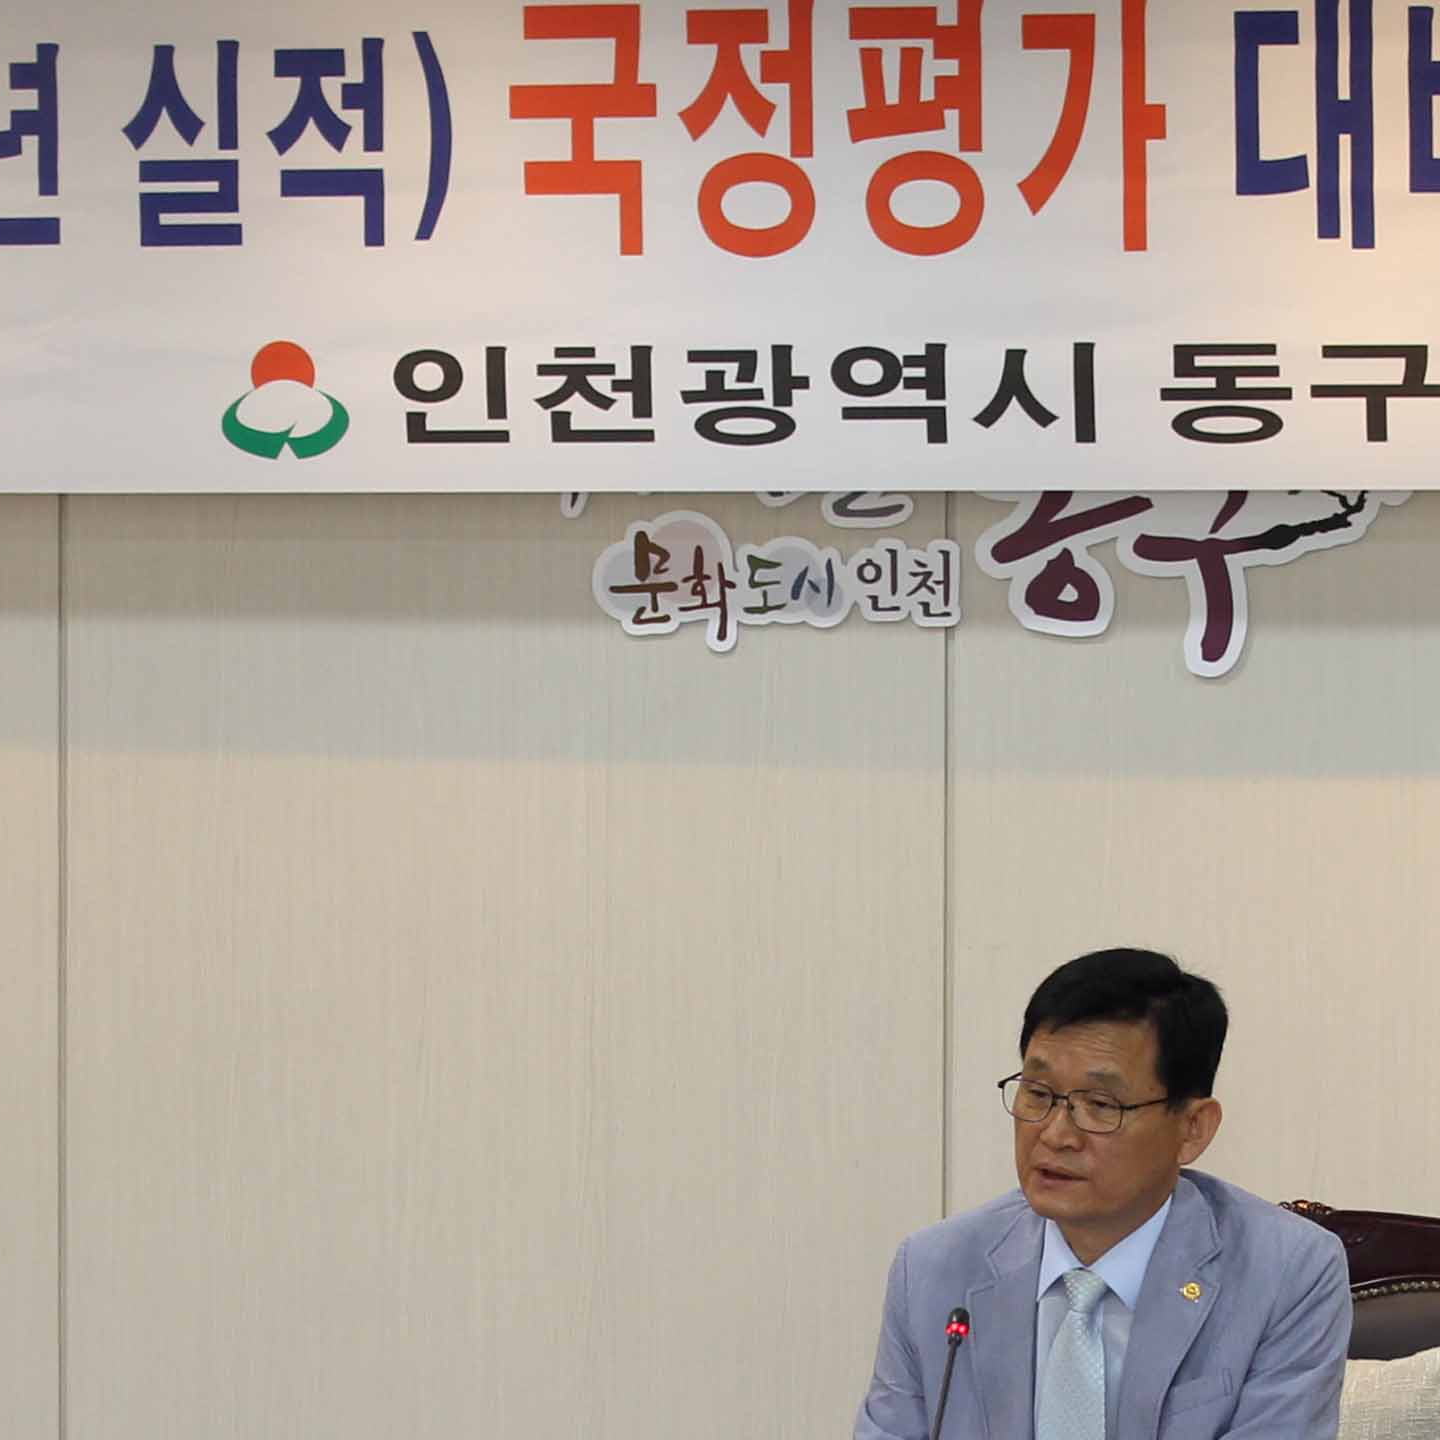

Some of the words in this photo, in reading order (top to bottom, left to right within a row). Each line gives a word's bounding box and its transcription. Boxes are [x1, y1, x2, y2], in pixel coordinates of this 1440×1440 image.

[121, 31, 452, 247] 실적)
[508, 0, 1167, 259] 국정평가
[392, 341, 1098, 447] 인천광역시
[609, 530, 835, 640] 문화도시
[857, 548, 952, 618] 인천
